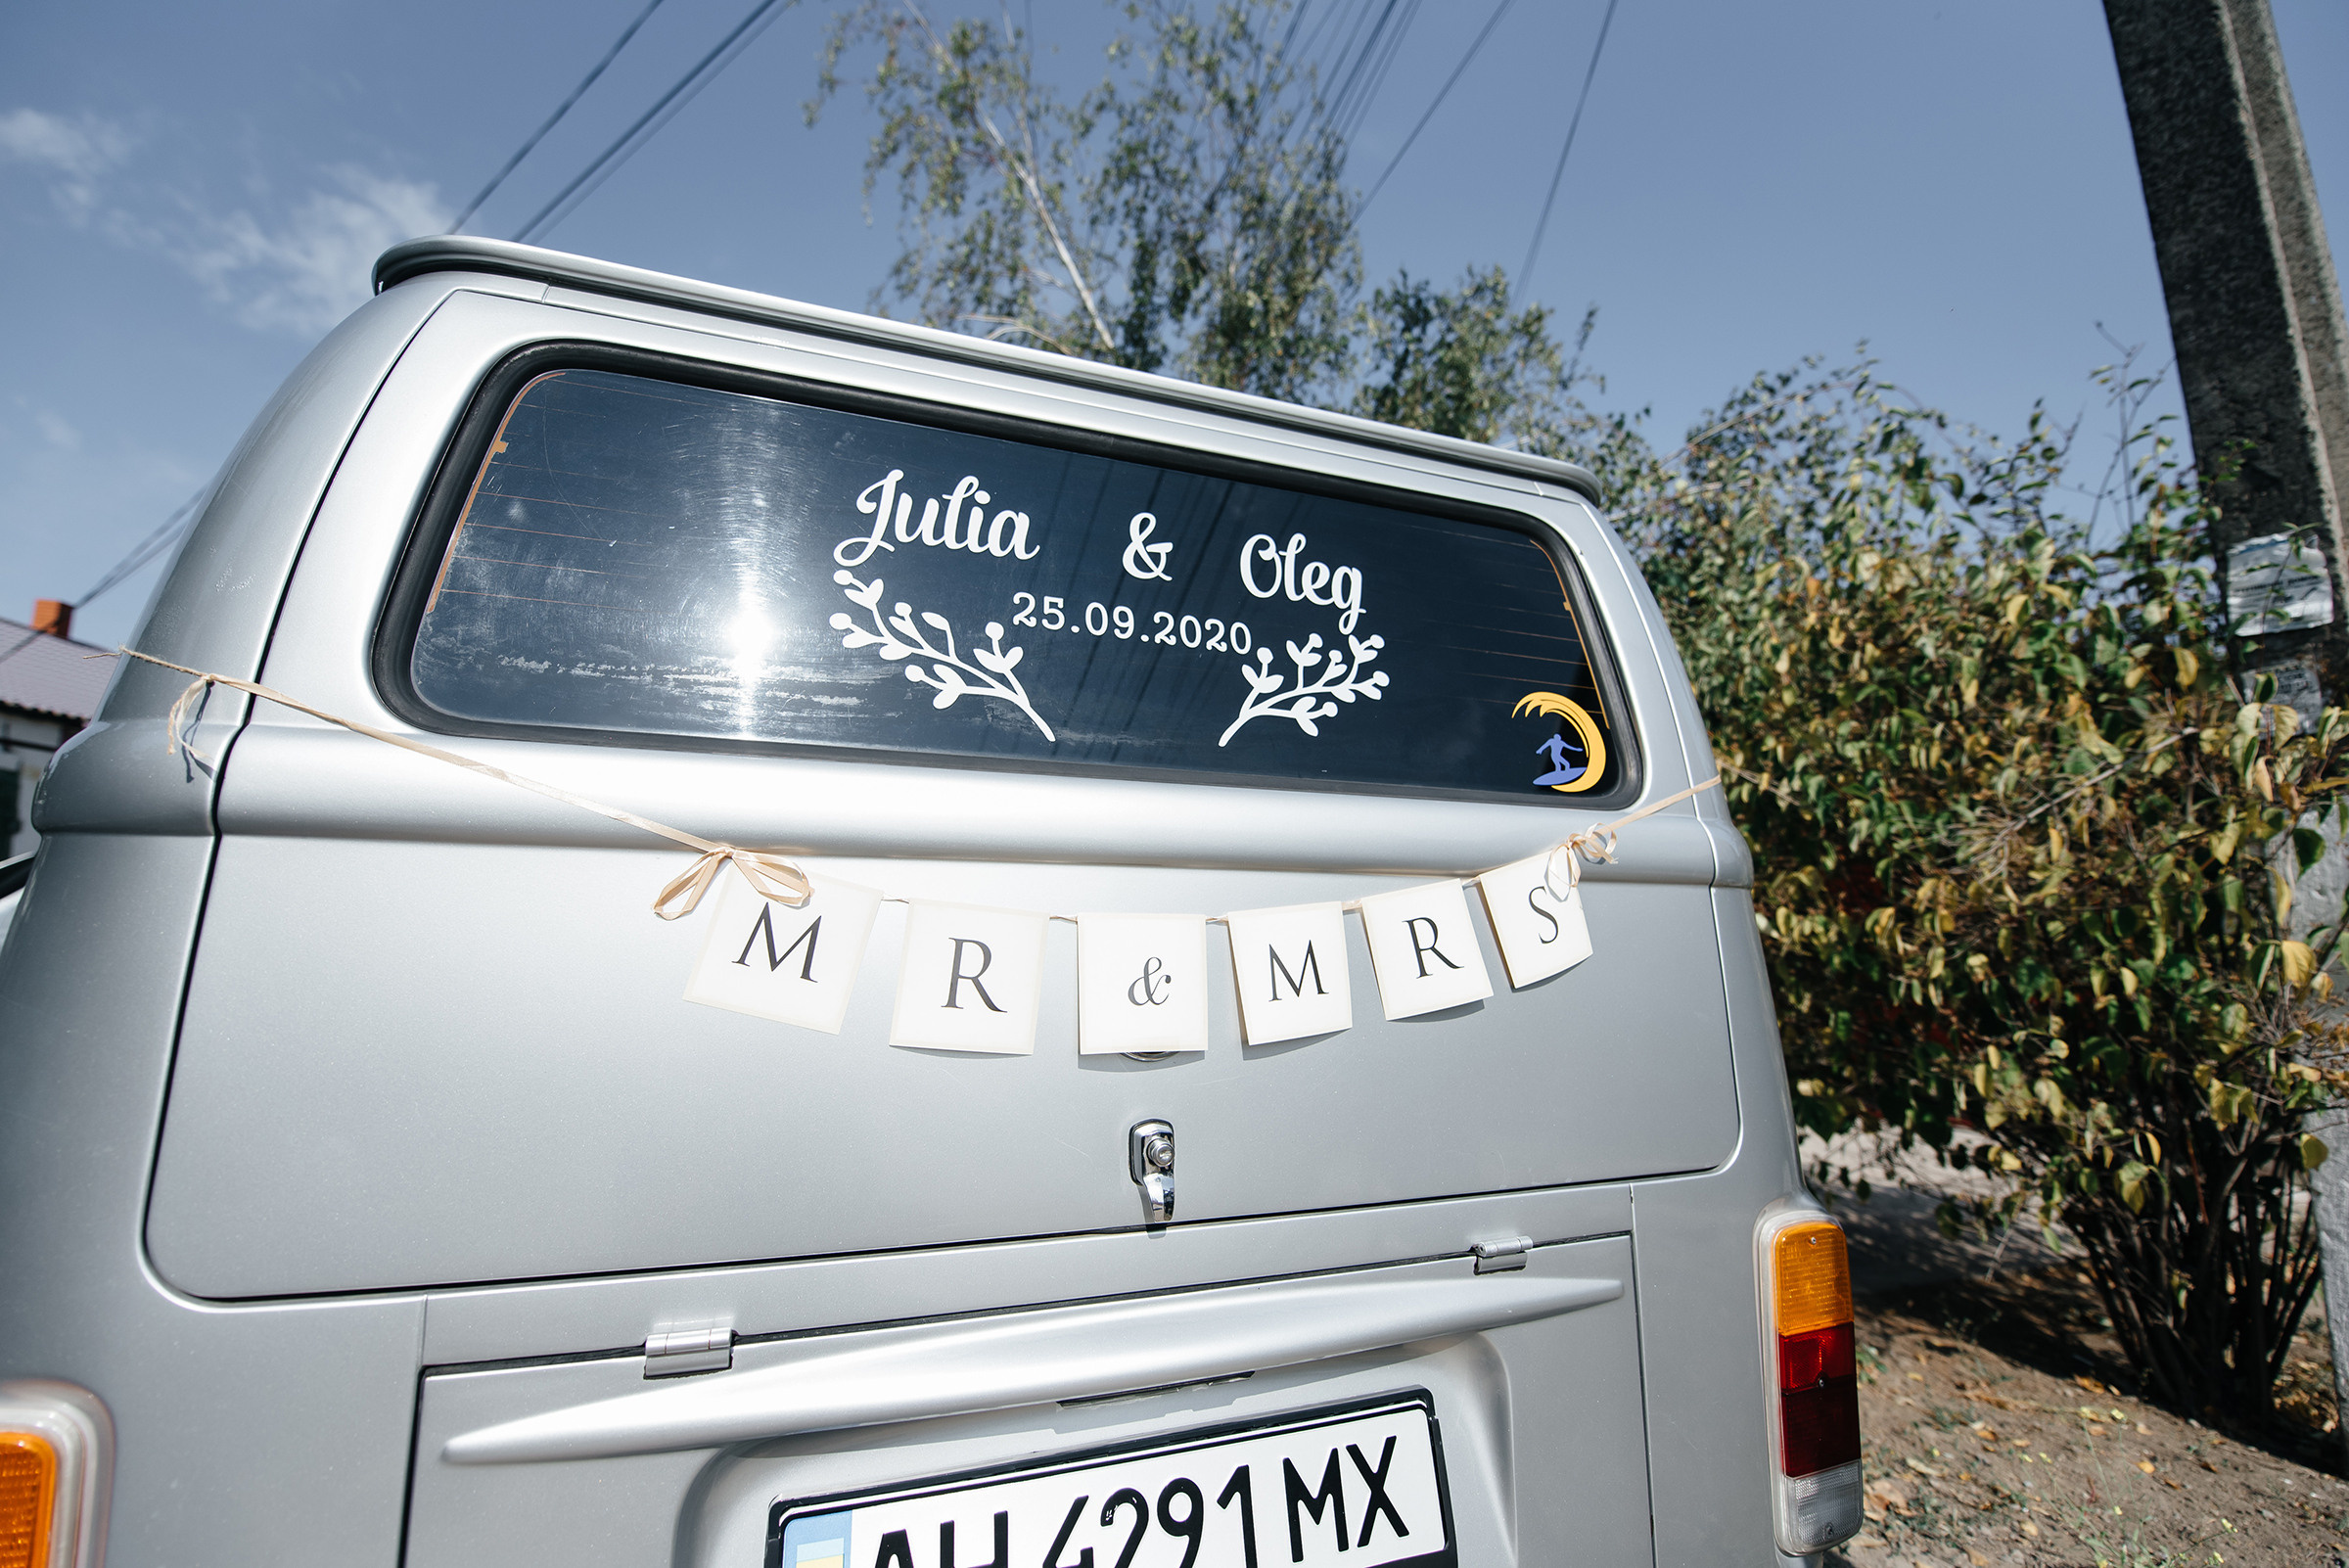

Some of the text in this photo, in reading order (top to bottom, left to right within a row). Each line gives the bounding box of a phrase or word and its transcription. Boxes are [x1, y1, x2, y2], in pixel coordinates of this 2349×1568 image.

[833, 469, 1367, 635] Julia & Oleg
[1012, 591, 1253, 655] 25.09.2020
[1128, 957, 1172, 1006] &
[1042, 1464, 1259, 1568] 4291
[1283, 1435, 1410, 1563] MX
